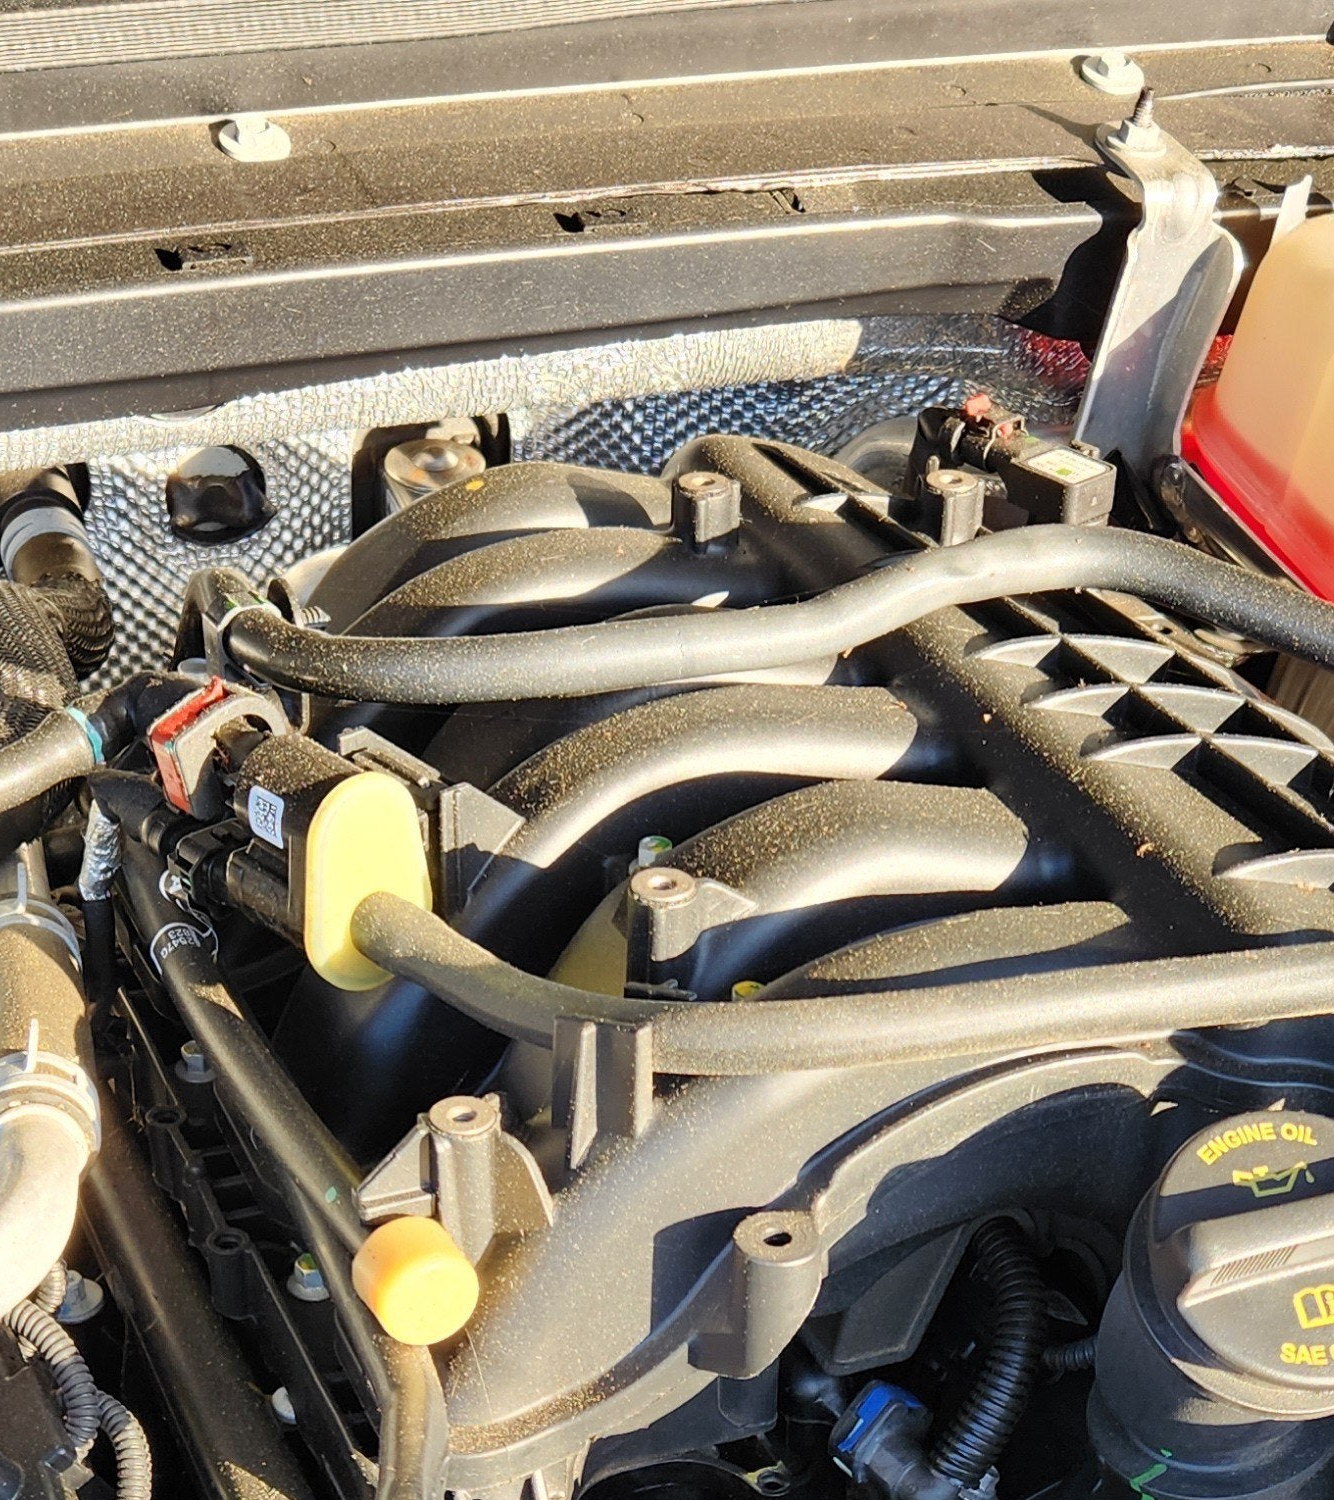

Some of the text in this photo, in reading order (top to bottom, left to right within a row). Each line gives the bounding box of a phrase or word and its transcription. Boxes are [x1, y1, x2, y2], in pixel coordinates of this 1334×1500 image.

[1196, 1123, 1317, 1165] ENGINE OIL
[1280, 1342, 1328, 1366] SAE
